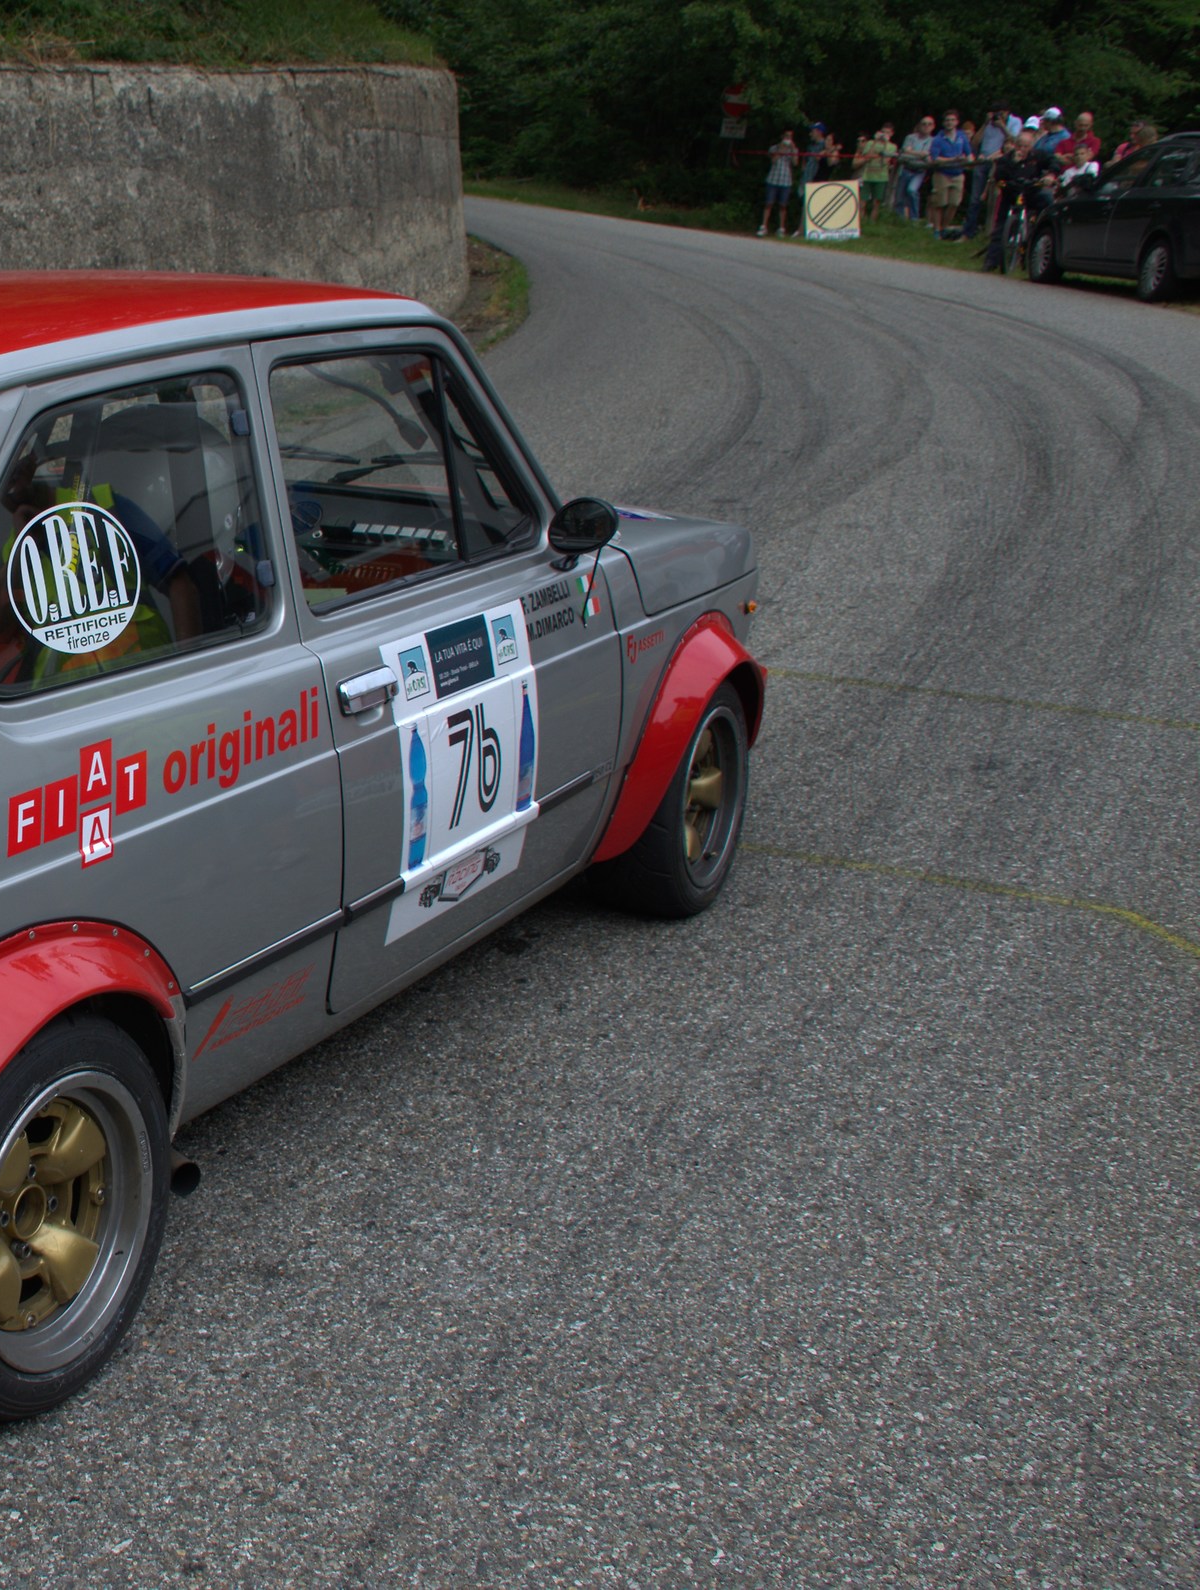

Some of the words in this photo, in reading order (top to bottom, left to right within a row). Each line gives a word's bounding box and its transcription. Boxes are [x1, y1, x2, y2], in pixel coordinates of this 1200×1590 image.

[528, 580, 571, 612] ZAMBELLI
[44, 612, 127, 642] RETTIFICHE
[68, 630, 110, 650] firenze
[639, 630, 665, 651] ASSETTI
[17, 751, 139, 843] FIAT
[163, 687, 319, 794] originali
[447, 702, 501, 829] 76
